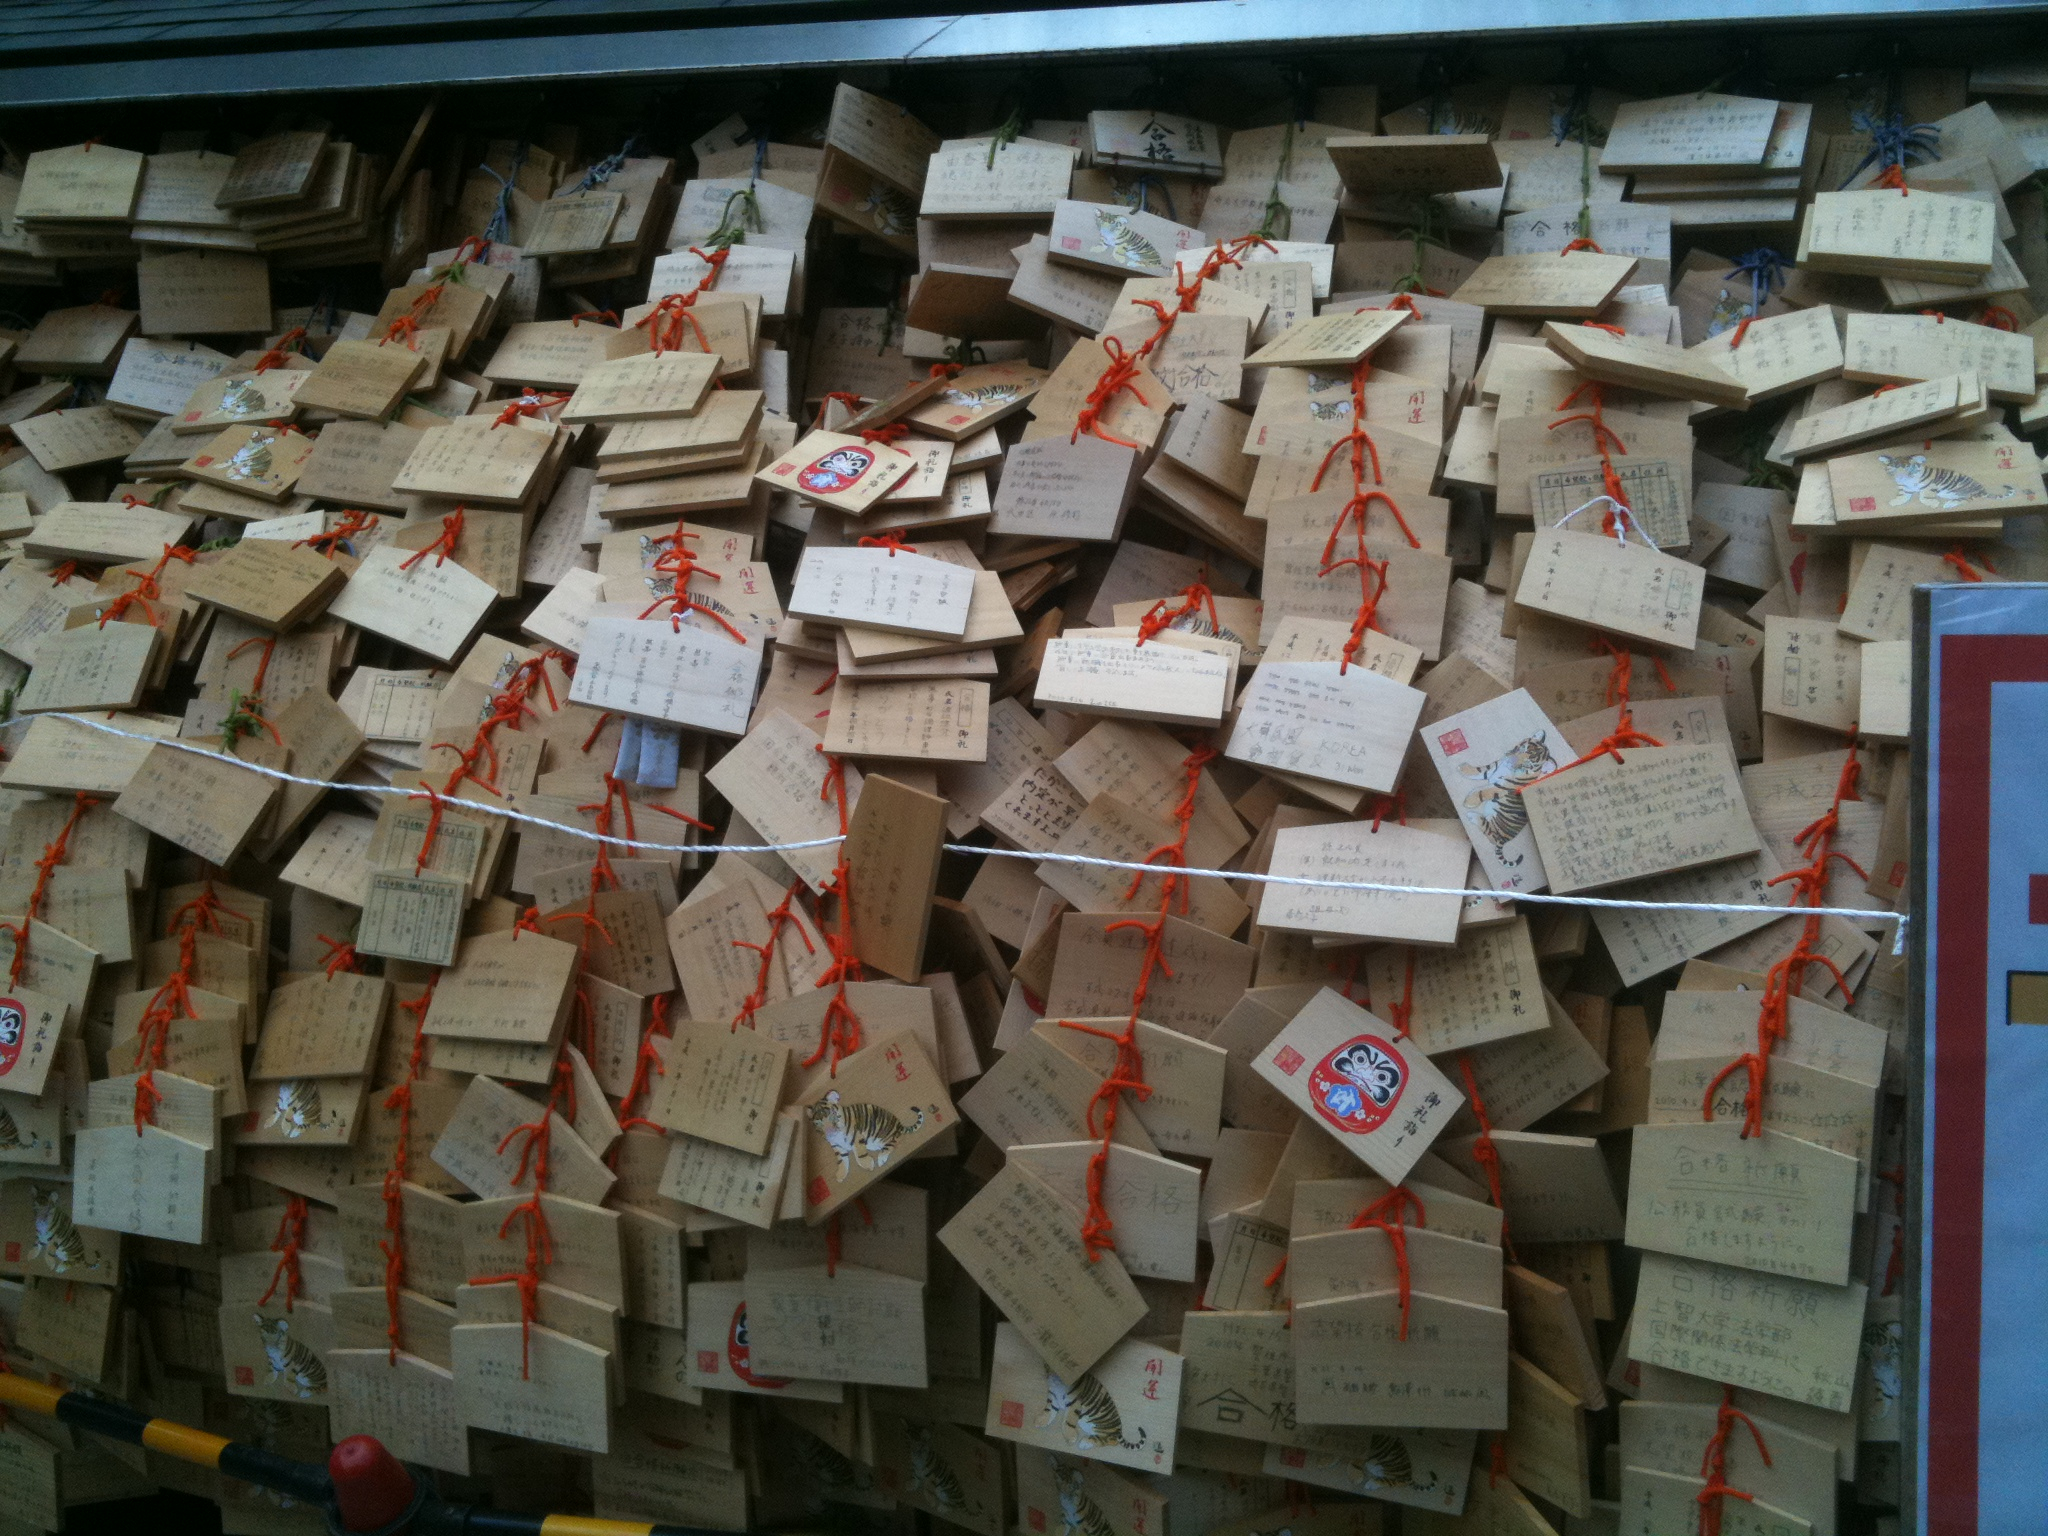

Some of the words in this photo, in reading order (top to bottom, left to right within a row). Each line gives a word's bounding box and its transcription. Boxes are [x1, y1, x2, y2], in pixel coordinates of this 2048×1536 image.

[1141, 119, 1175, 163] 合格
[1408, 390, 1425, 423] 開運
[1994, 445, 2014, 469] 開運
[739, 566, 758, 594] 開運
[1319, 740, 1367, 757] KOREA
[885, 1042, 910, 1082] 開運
[1394, 1091, 1440, 1148] 御礼詣り
[1673, 1145, 1803, 1184] 合格祈願
[1115, 1179, 1182, 1217] 合格
[1672, 1261, 1820, 1327] 合格祈願
[1650, 1296, 1792, 1343] 上智大学法学部
[1142, 1358, 1163, 1400] 開運
[1132, 1498, 1147, 1535] 開運
